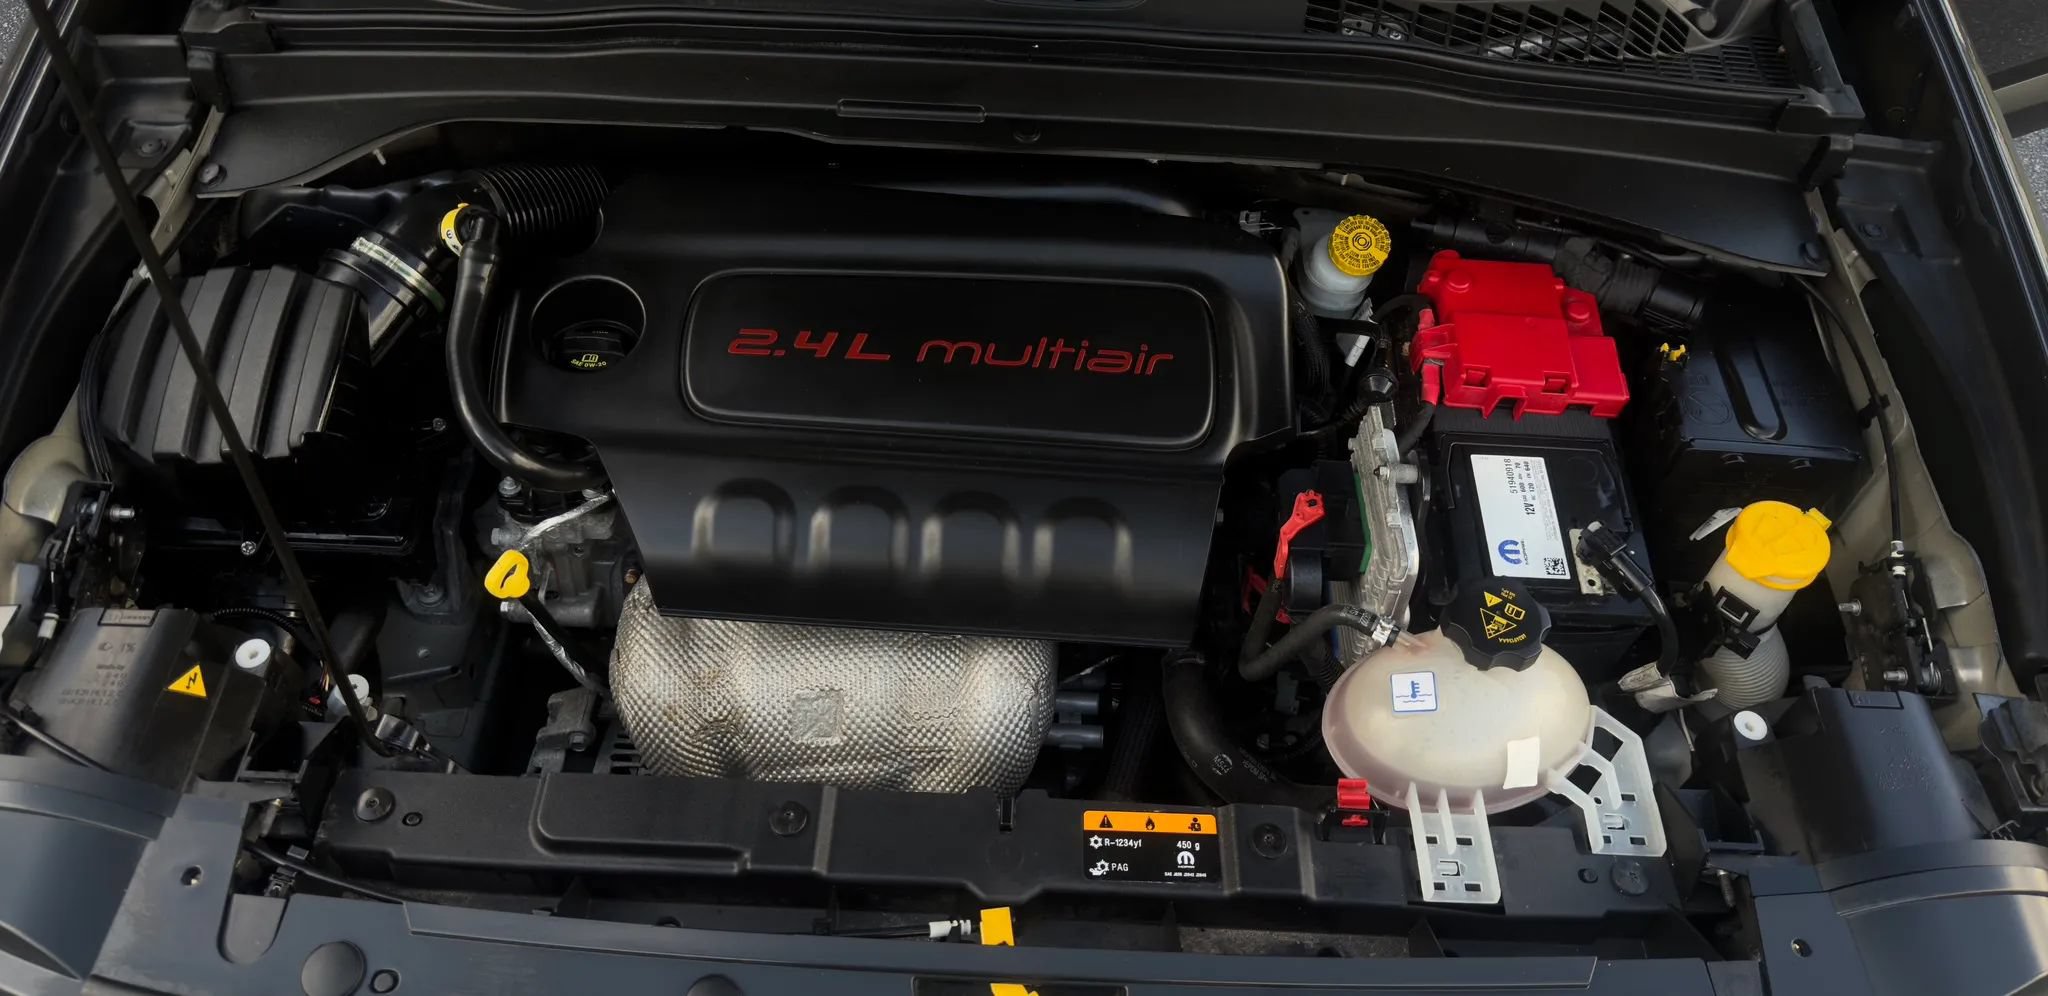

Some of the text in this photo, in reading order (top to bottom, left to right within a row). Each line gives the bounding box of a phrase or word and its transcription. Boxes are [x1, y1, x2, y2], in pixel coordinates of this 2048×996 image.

[916, 337, 1174, 376] multiair
[1504, 458, 1518, 494] 51940918
[1524, 502, 1535, 515] 12V
[1104, 838, 1142, 849] R-1234yf
[1176, 840, 1200, 851] 450 g
[1111, 863, 1129, 872] PAG
